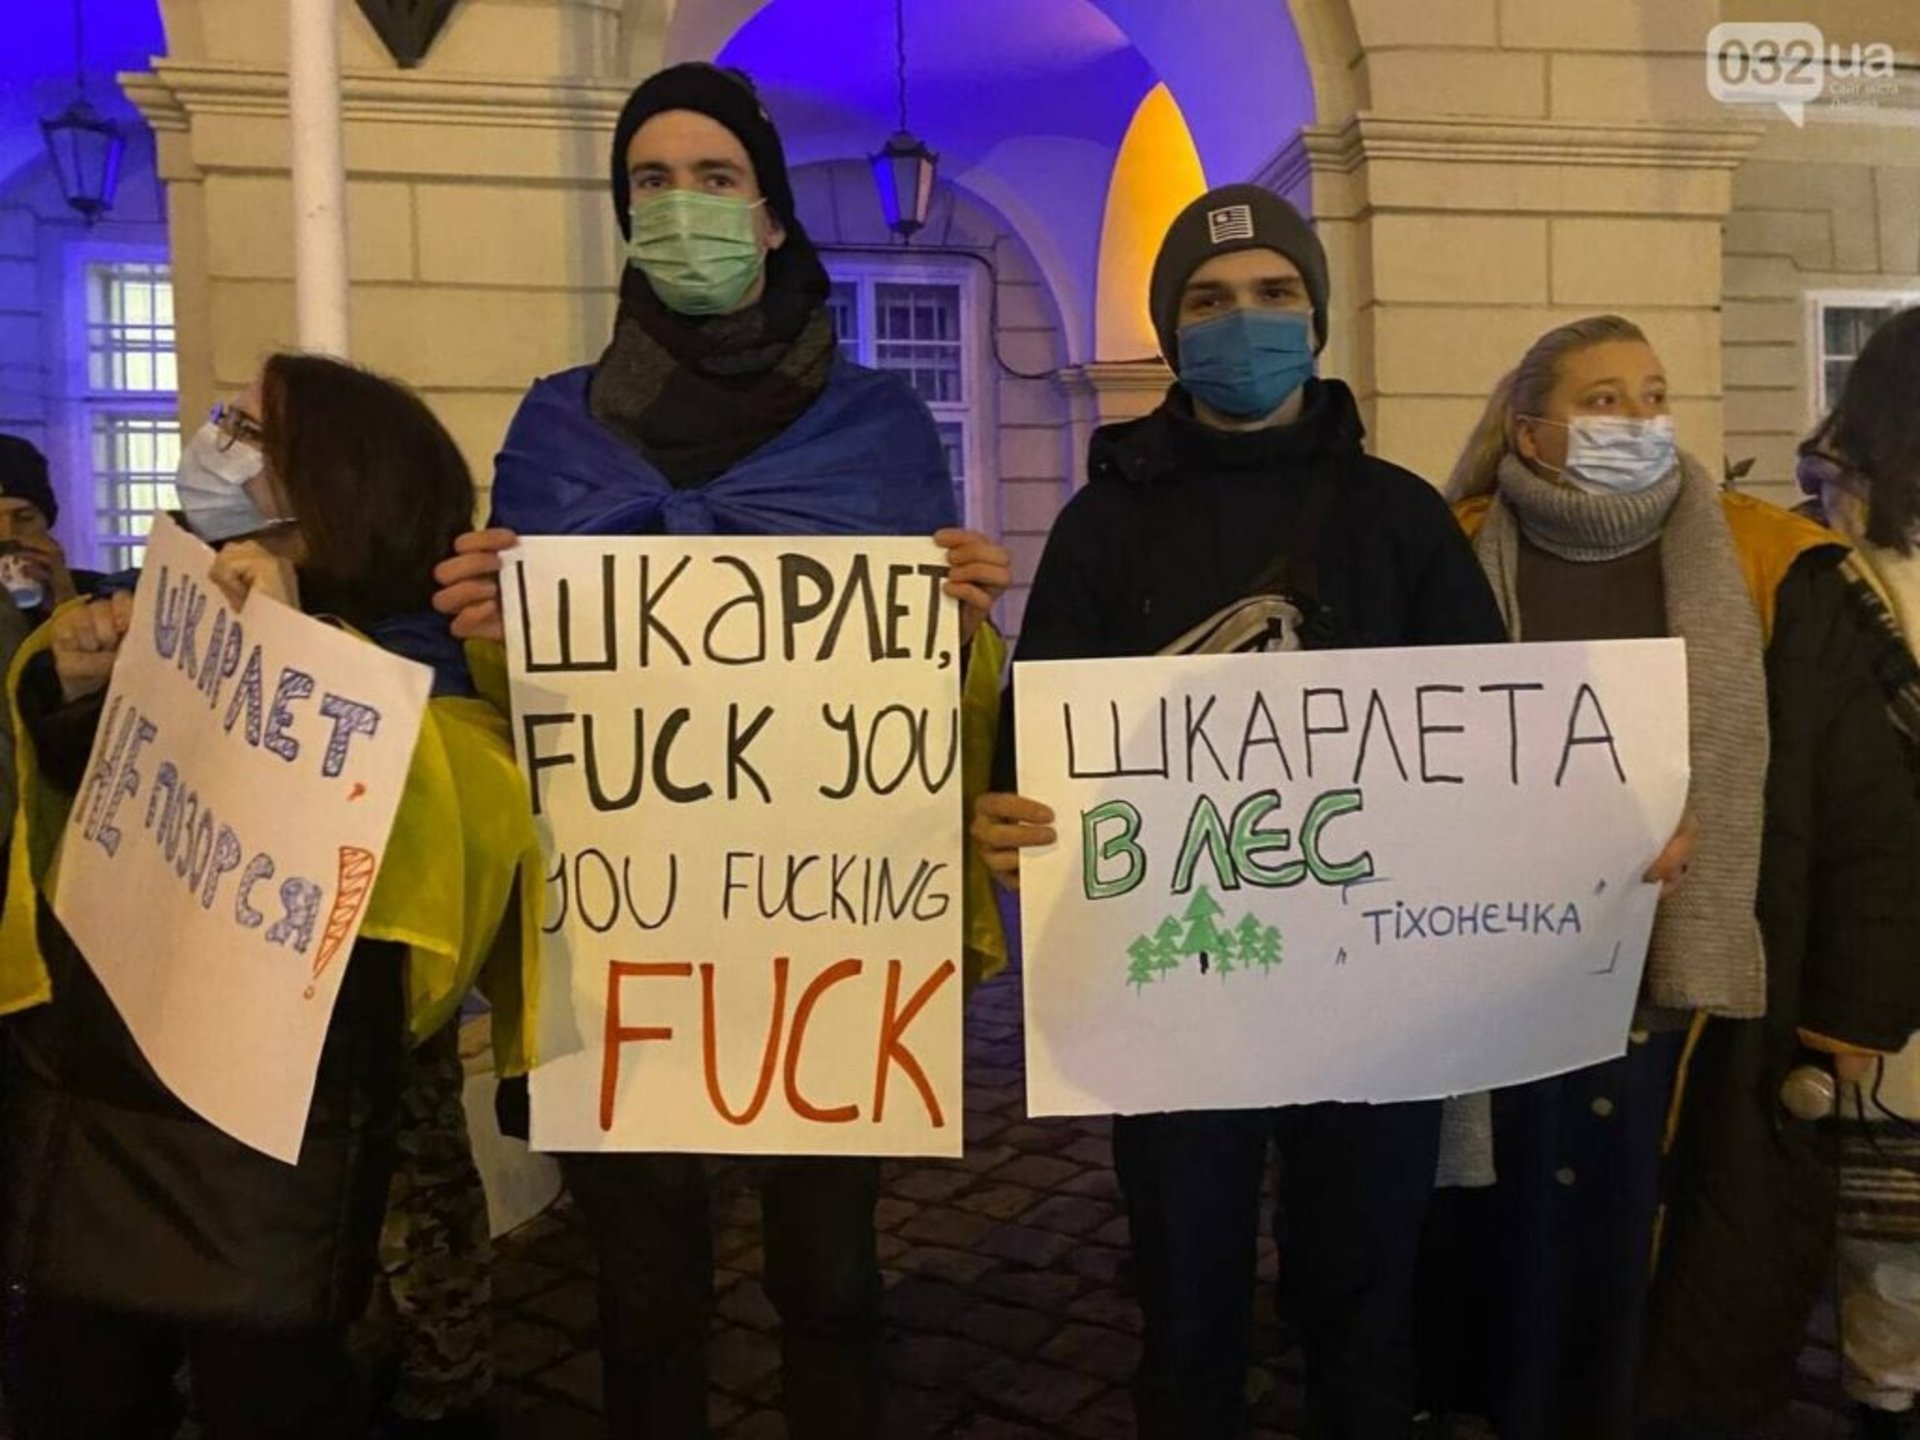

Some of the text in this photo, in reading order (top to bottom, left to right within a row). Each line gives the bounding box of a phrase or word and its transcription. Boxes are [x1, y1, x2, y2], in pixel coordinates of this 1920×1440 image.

[74, 695, 158, 859] НЕ
[523, 703, 775, 815] FUCK
[1063, 682, 1626, 786] ШКАРЛЕТА
[722, 851, 951, 926] FUCKING
[1081, 800, 1147, 900] В
[599, 956, 957, 1132] FUCK
